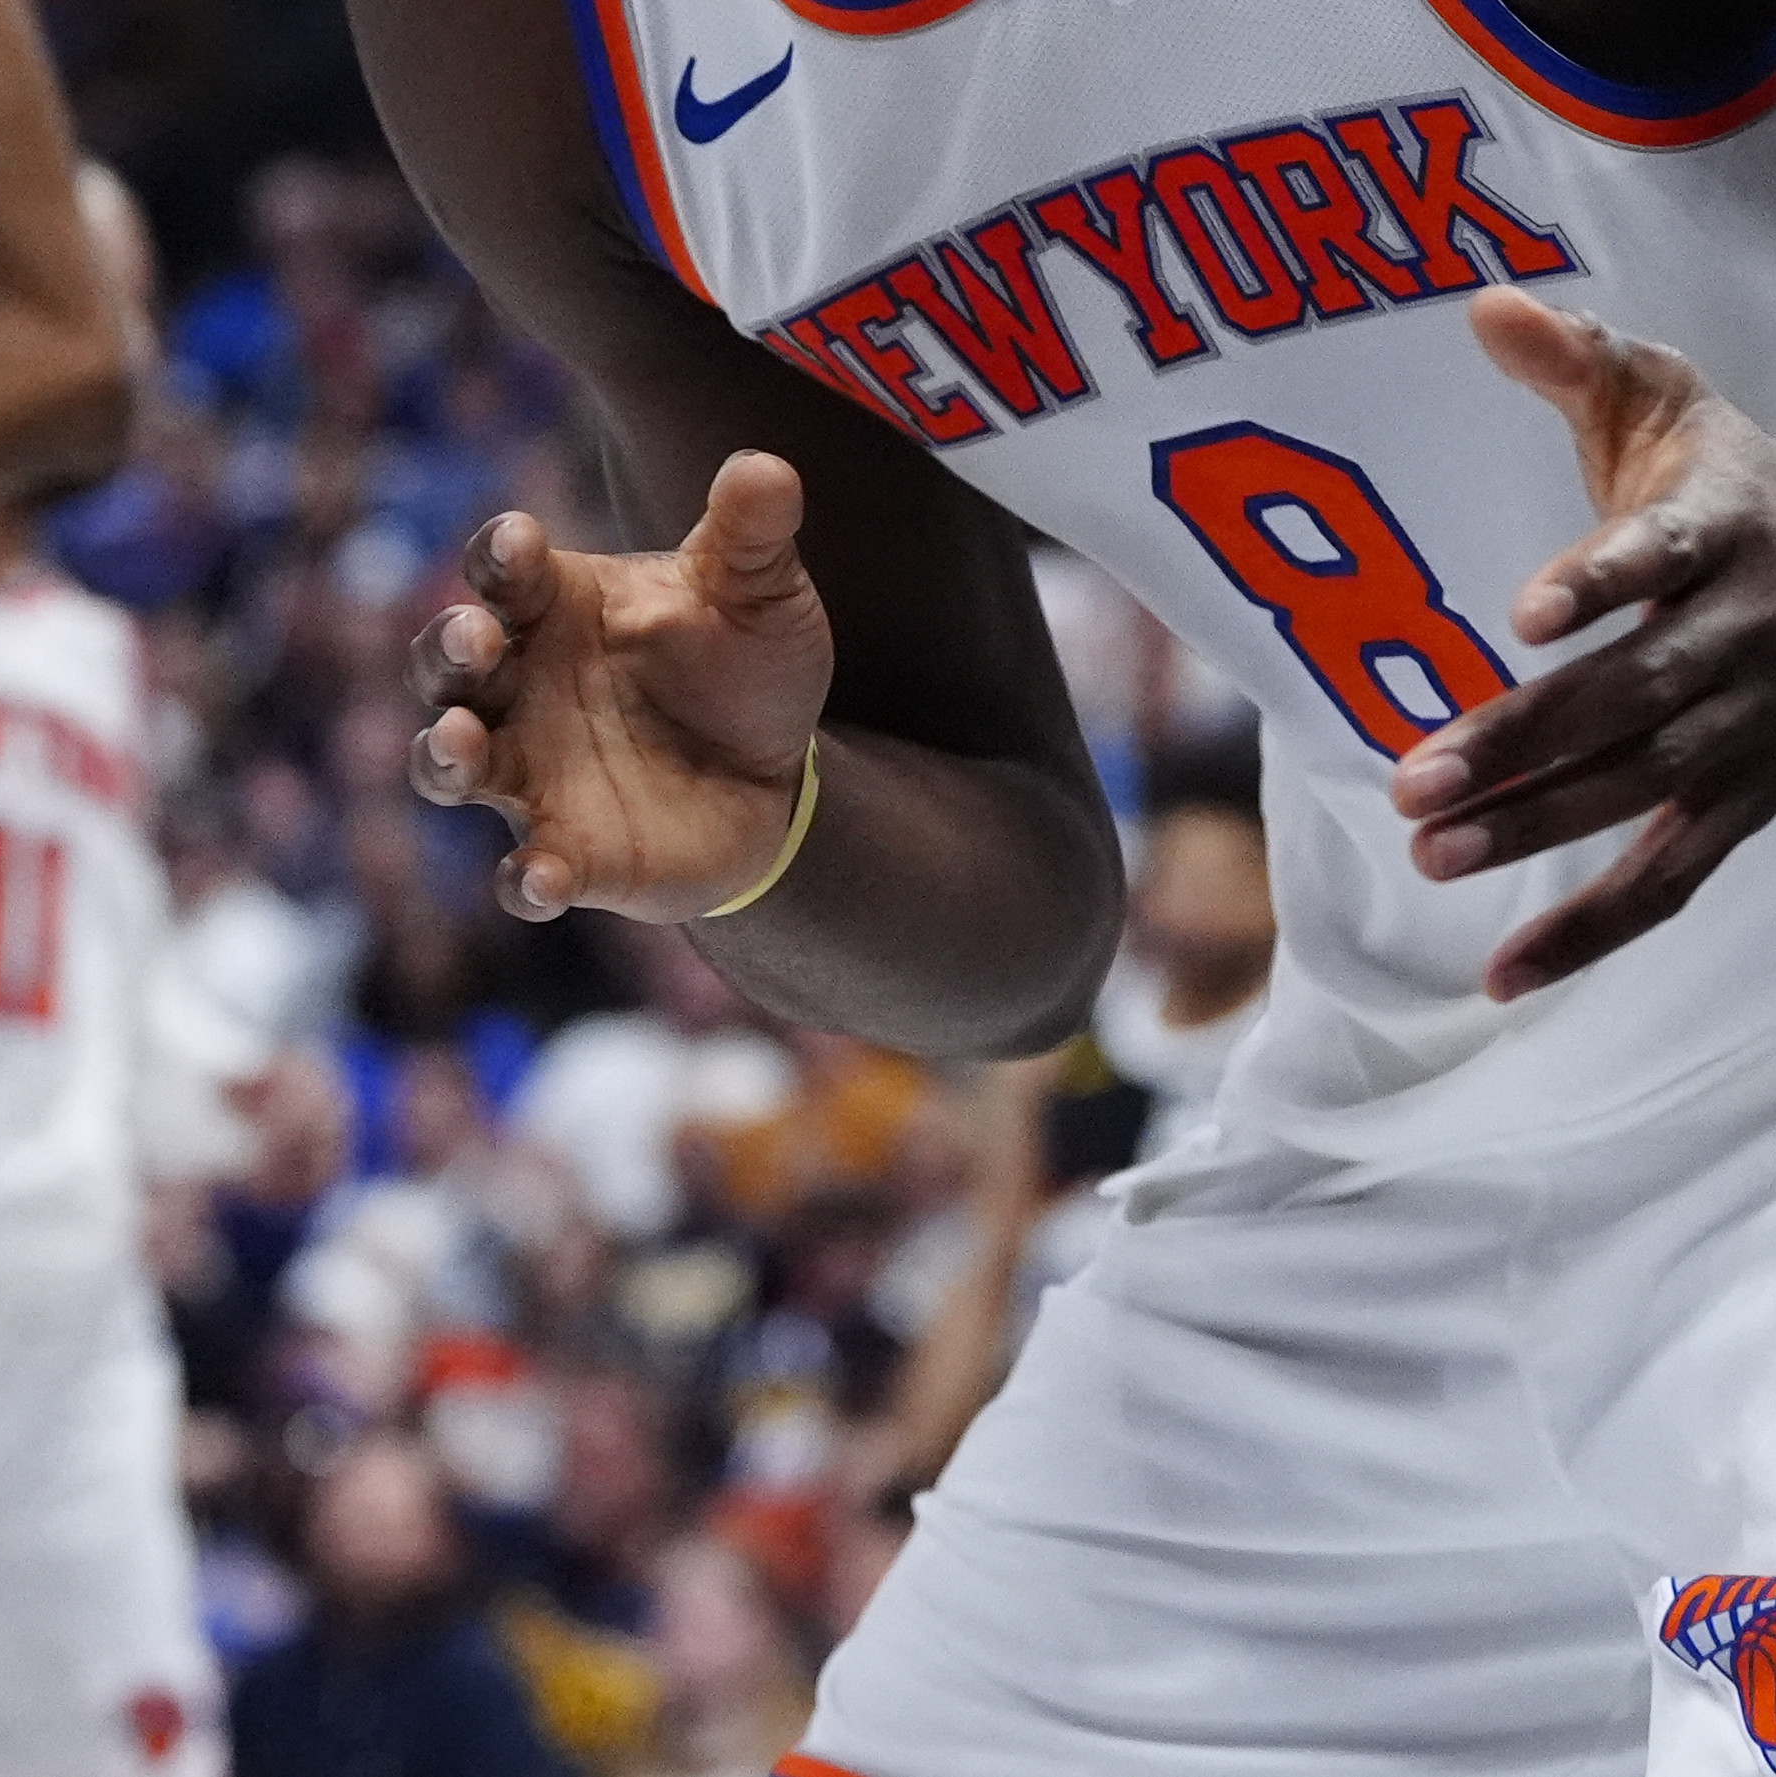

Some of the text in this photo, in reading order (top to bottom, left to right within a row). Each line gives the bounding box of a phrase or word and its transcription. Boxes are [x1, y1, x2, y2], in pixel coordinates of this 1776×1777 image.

[756, 91, 1588, 449] NEW YORK
[1150, 420, 1522, 769] 8
